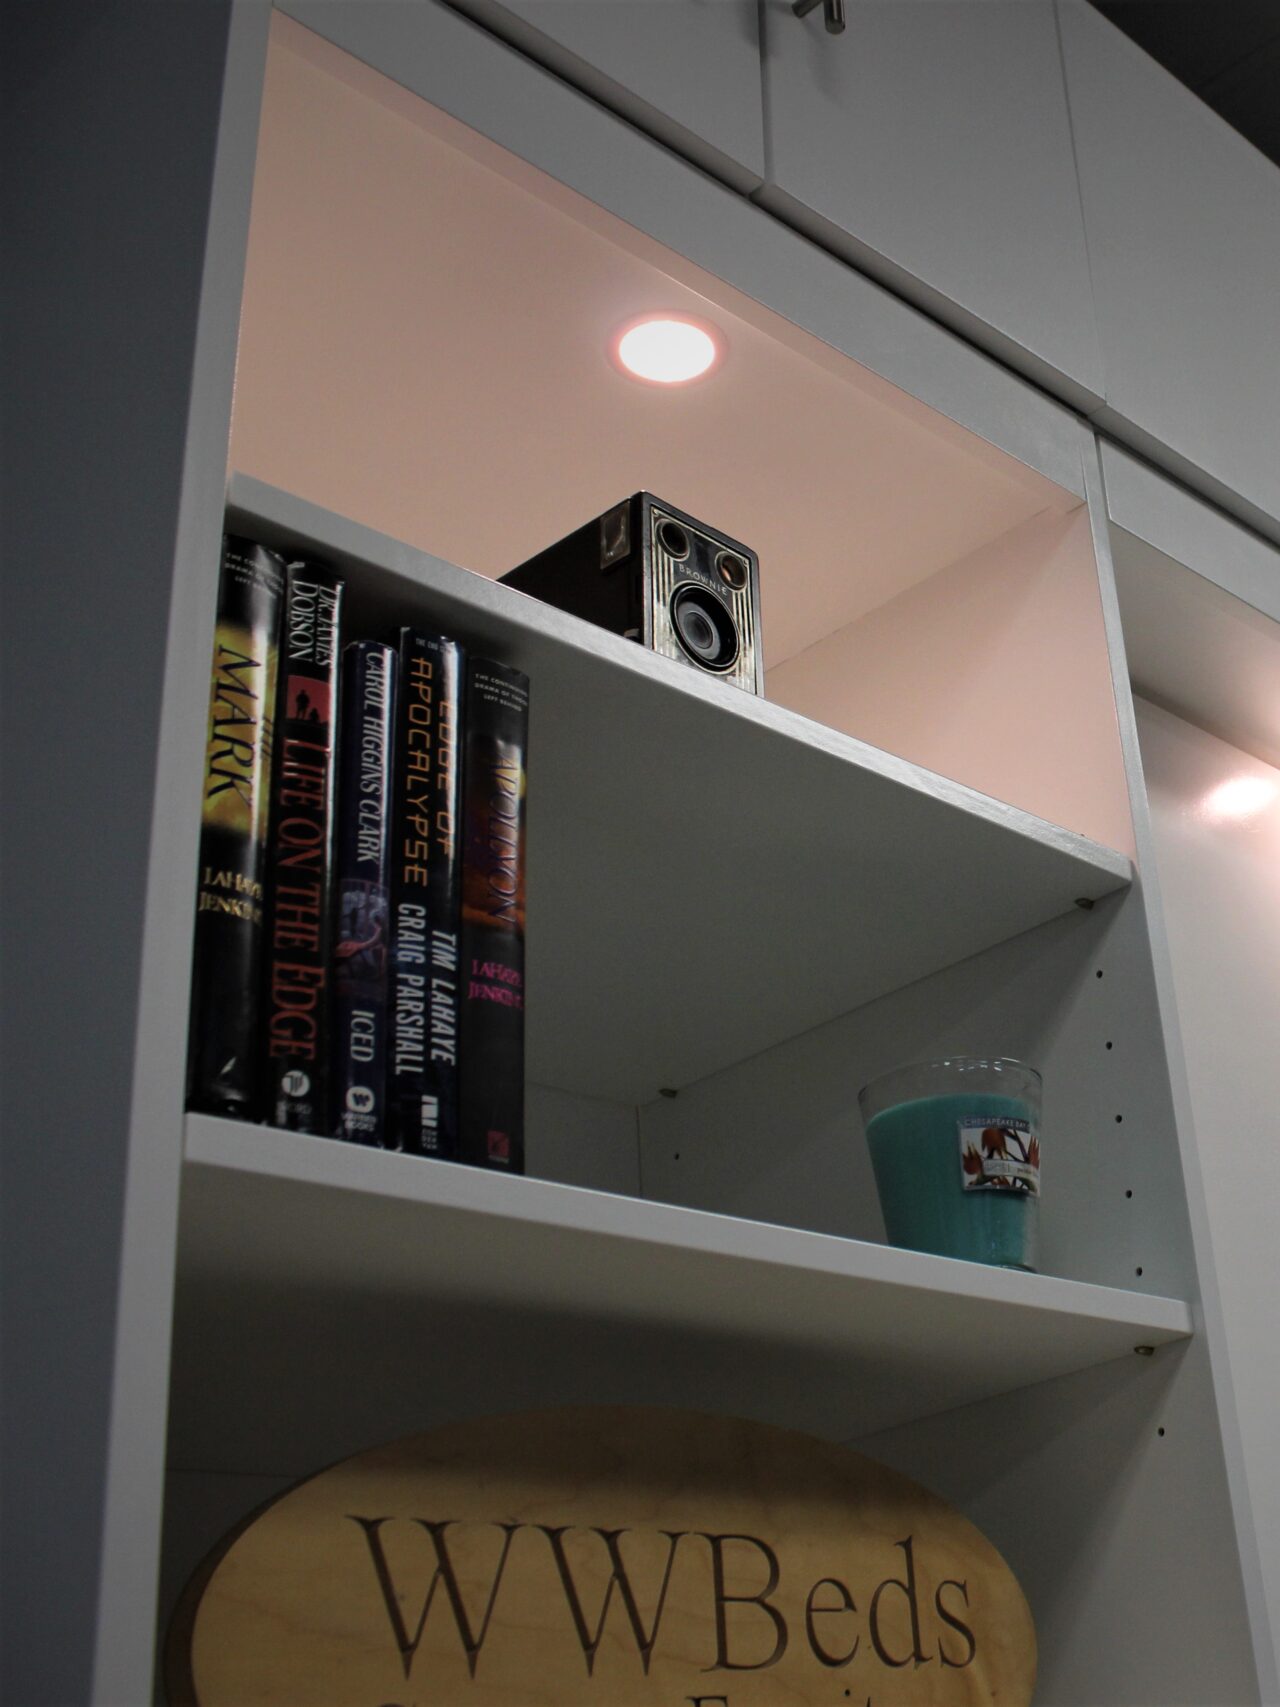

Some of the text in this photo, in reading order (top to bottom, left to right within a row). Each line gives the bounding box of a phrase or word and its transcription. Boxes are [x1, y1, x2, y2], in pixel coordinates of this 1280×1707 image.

[288, 580, 318, 662] DOBSON
[678, 563, 728, 597] BROWNIE
[207, 644, 262, 808] MARK
[356, 652, 386, 864] CAROL HIGGINS CLARK
[404, 656, 433, 888] APOCALYPSE
[268, 735, 331, 1060] LIFE ON THE EDGE
[350, 1009, 375, 1063] ICED
[394, 903, 426, 1076] CRAIG PARSHALL
[430, 929, 457, 1067] TIM LAHAYE
[344, 1514, 977, 1680] WWBeds
